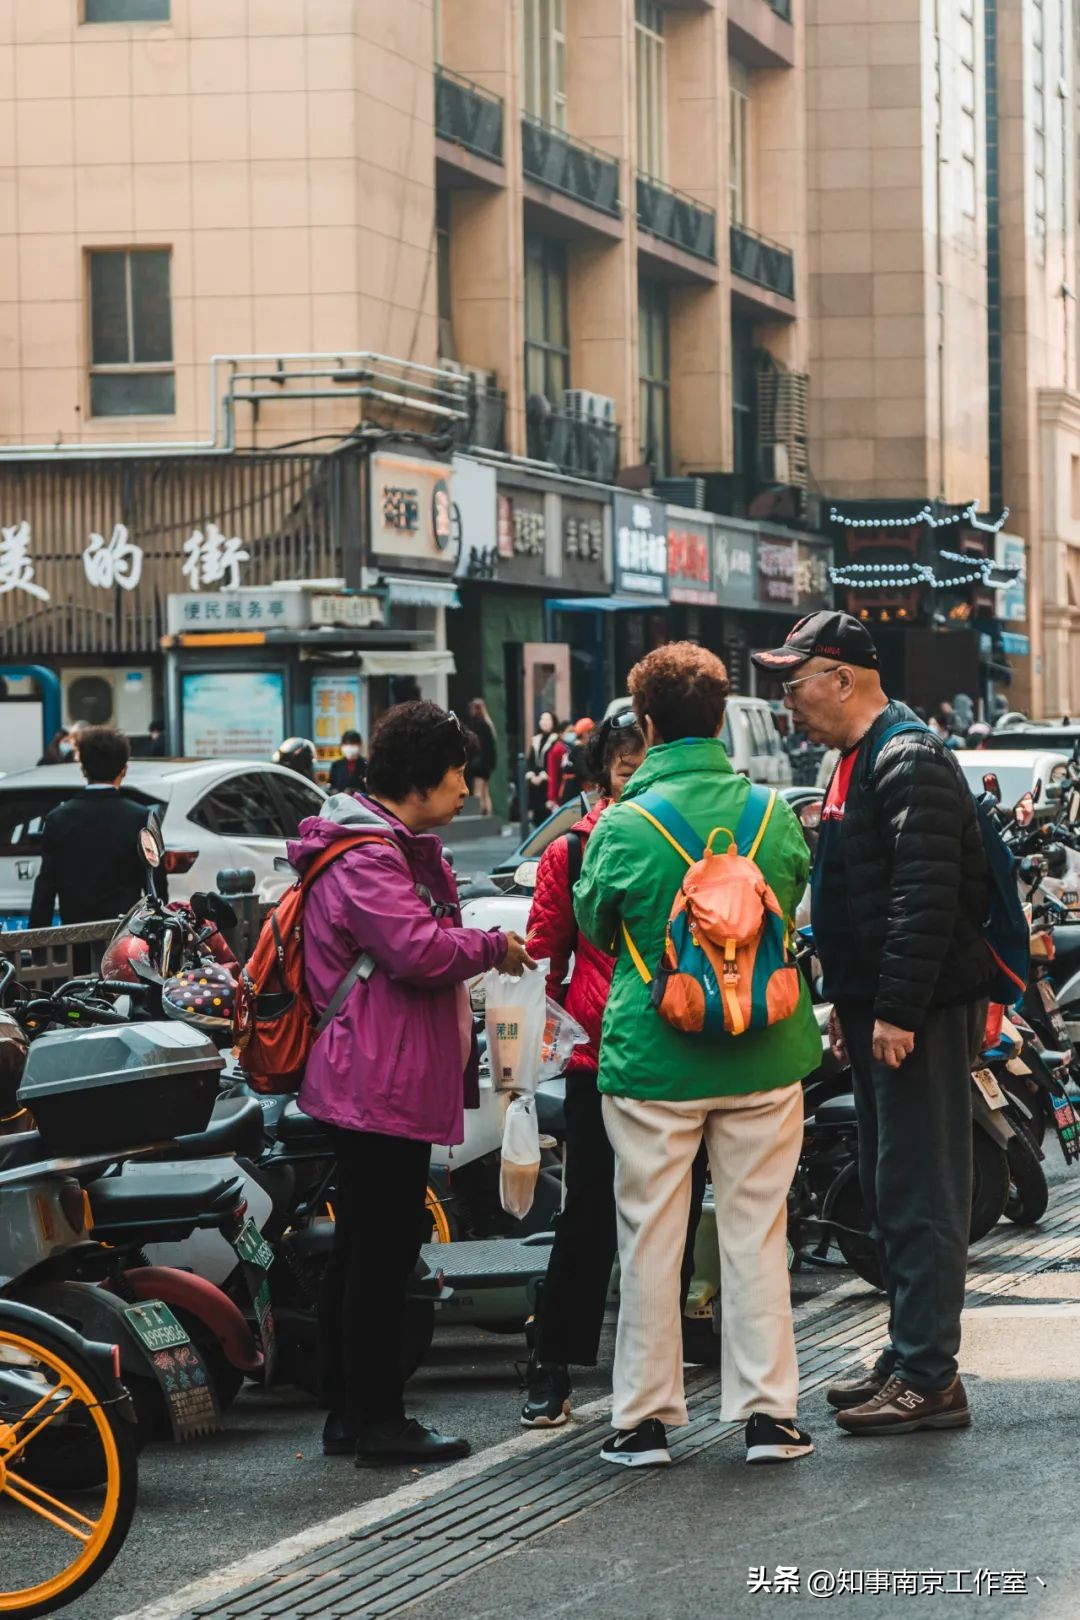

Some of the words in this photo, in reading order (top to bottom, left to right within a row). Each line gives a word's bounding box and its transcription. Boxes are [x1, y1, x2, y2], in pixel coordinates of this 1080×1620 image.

[184, 600, 285, 620] 便民服务亭
